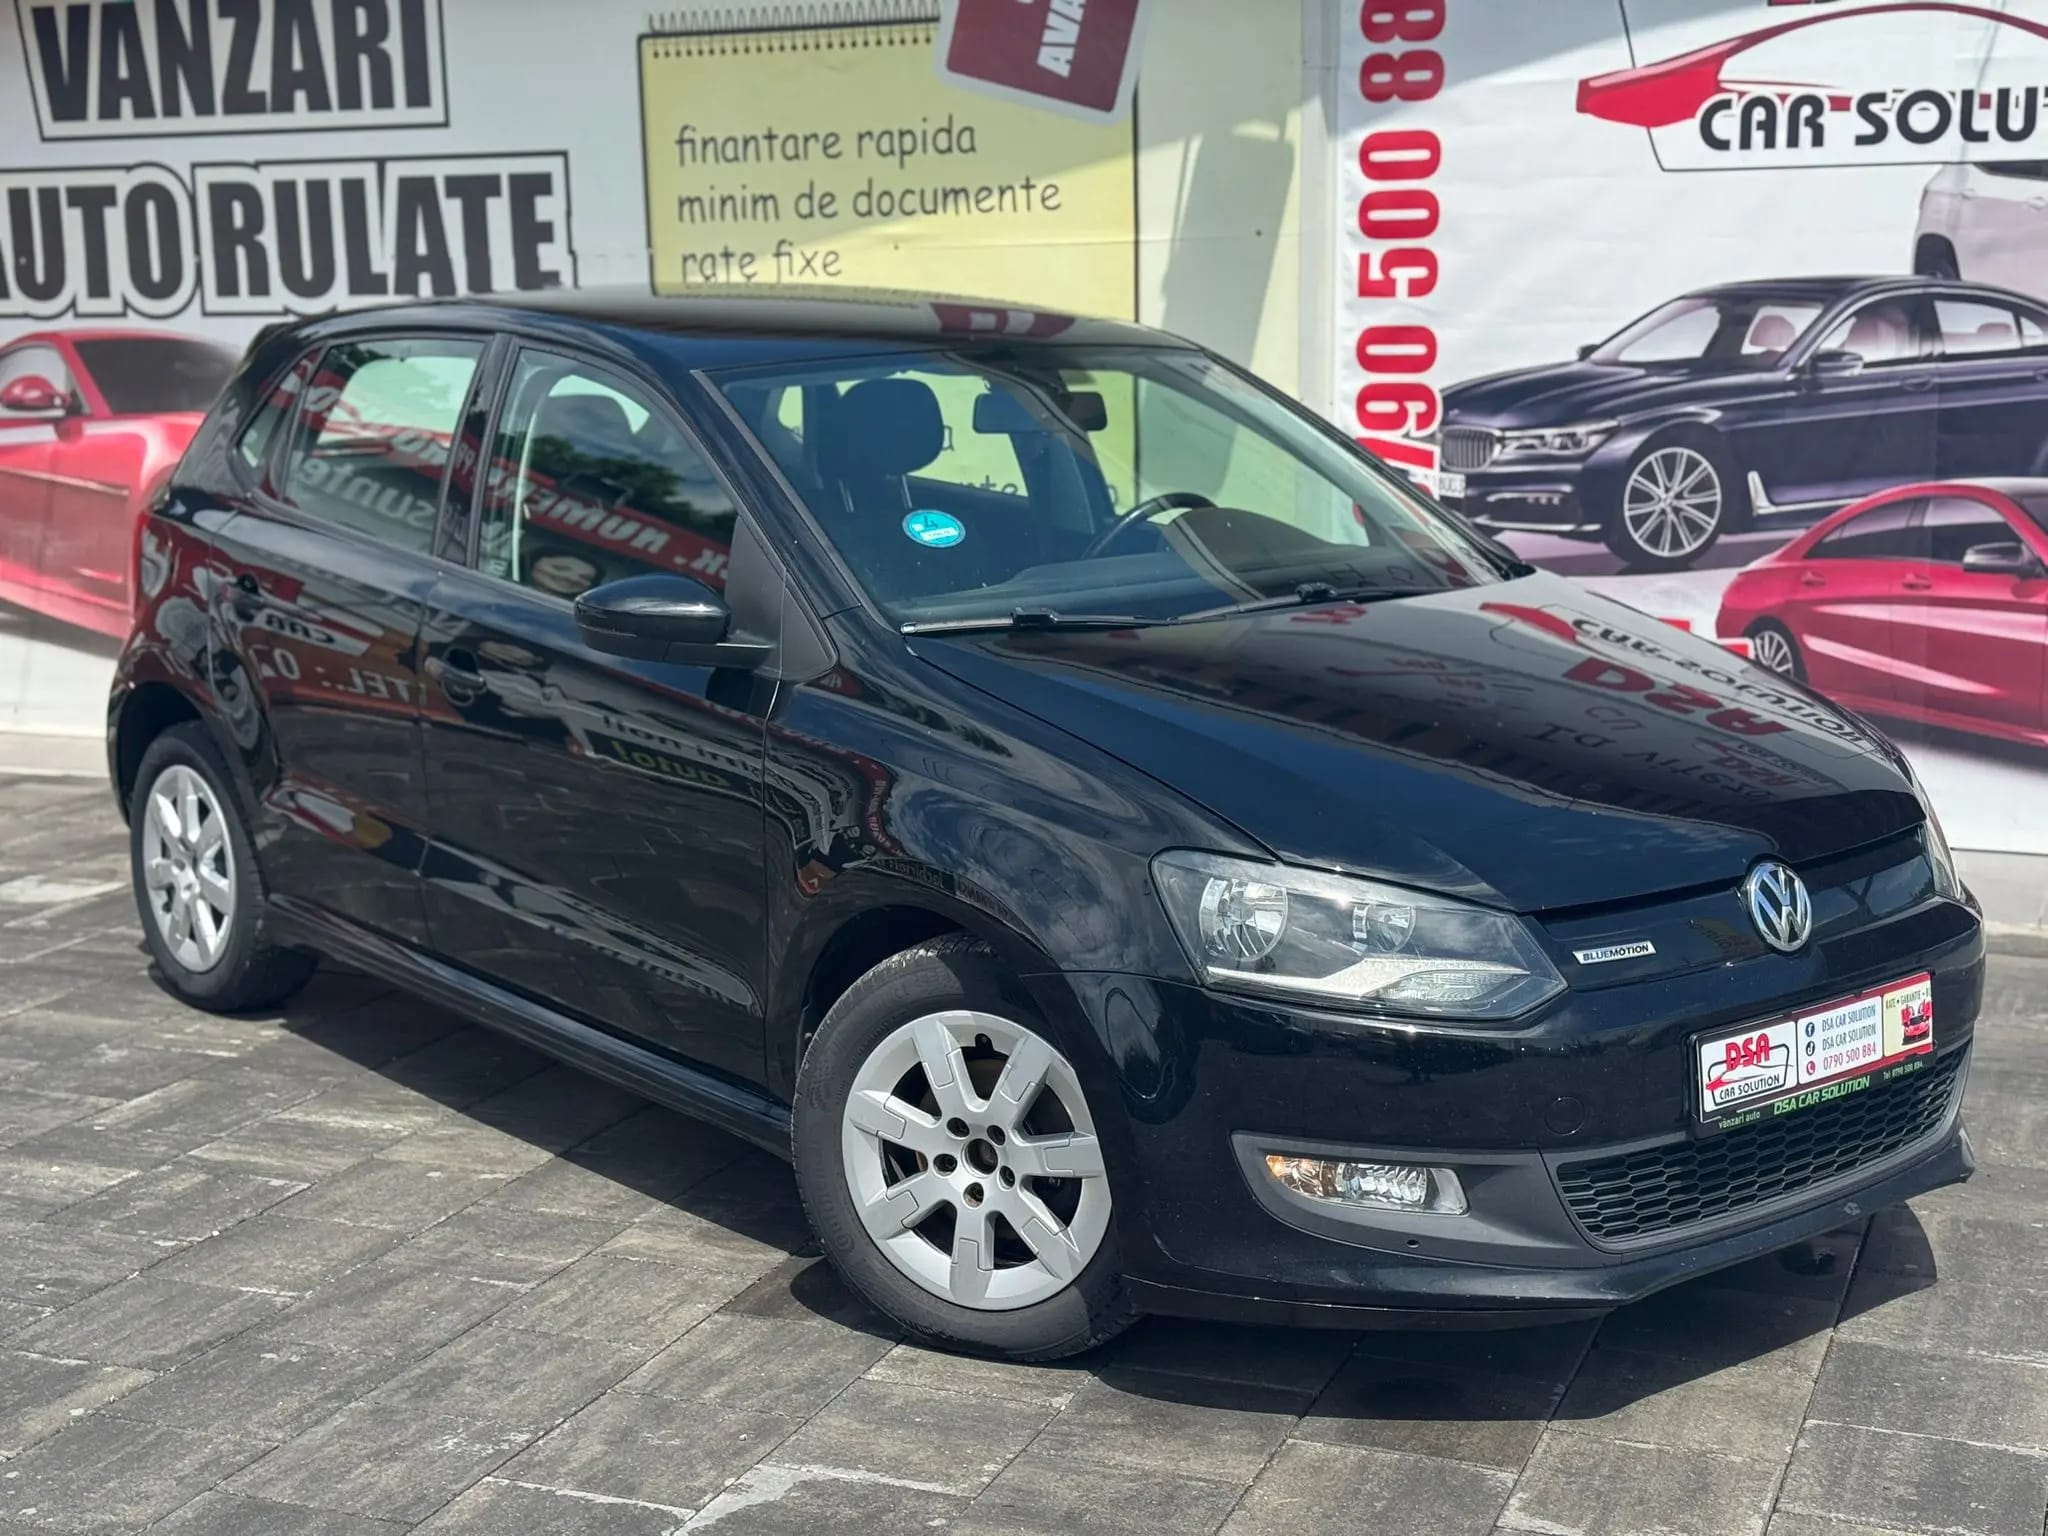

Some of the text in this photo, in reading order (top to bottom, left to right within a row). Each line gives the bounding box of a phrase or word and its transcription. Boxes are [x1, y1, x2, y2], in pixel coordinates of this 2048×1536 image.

[1699, 86, 2048, 151] CAR SOLU
[674, 113, 977, 168] finantare rapida
[677, 176, 1063, 223] minim de documente
[1357, 130, 1442, 299] 500
[0, 172, 561, 301] UTO RULATE
[681, 238, 842, 286] rate fixe
[1582, 943, 1650, 962] BLUEMOTION
[1821, 1004, 1876, 1033] DSA CAR SOLUTION
[1822, 1023, 1877, 1051] DSA CAR SOLUTION
[1725, 1033, 1770, 1071] DSA
[1823, 1041, 1877, 1070] 0790 500 884
[1719, 1073, 1780, 1100] CAR SOLUTION
[1773, 1075, 1871, 1115] DSA CAR SOLUTION
[1745, 1111, 1761, 1122] auto
